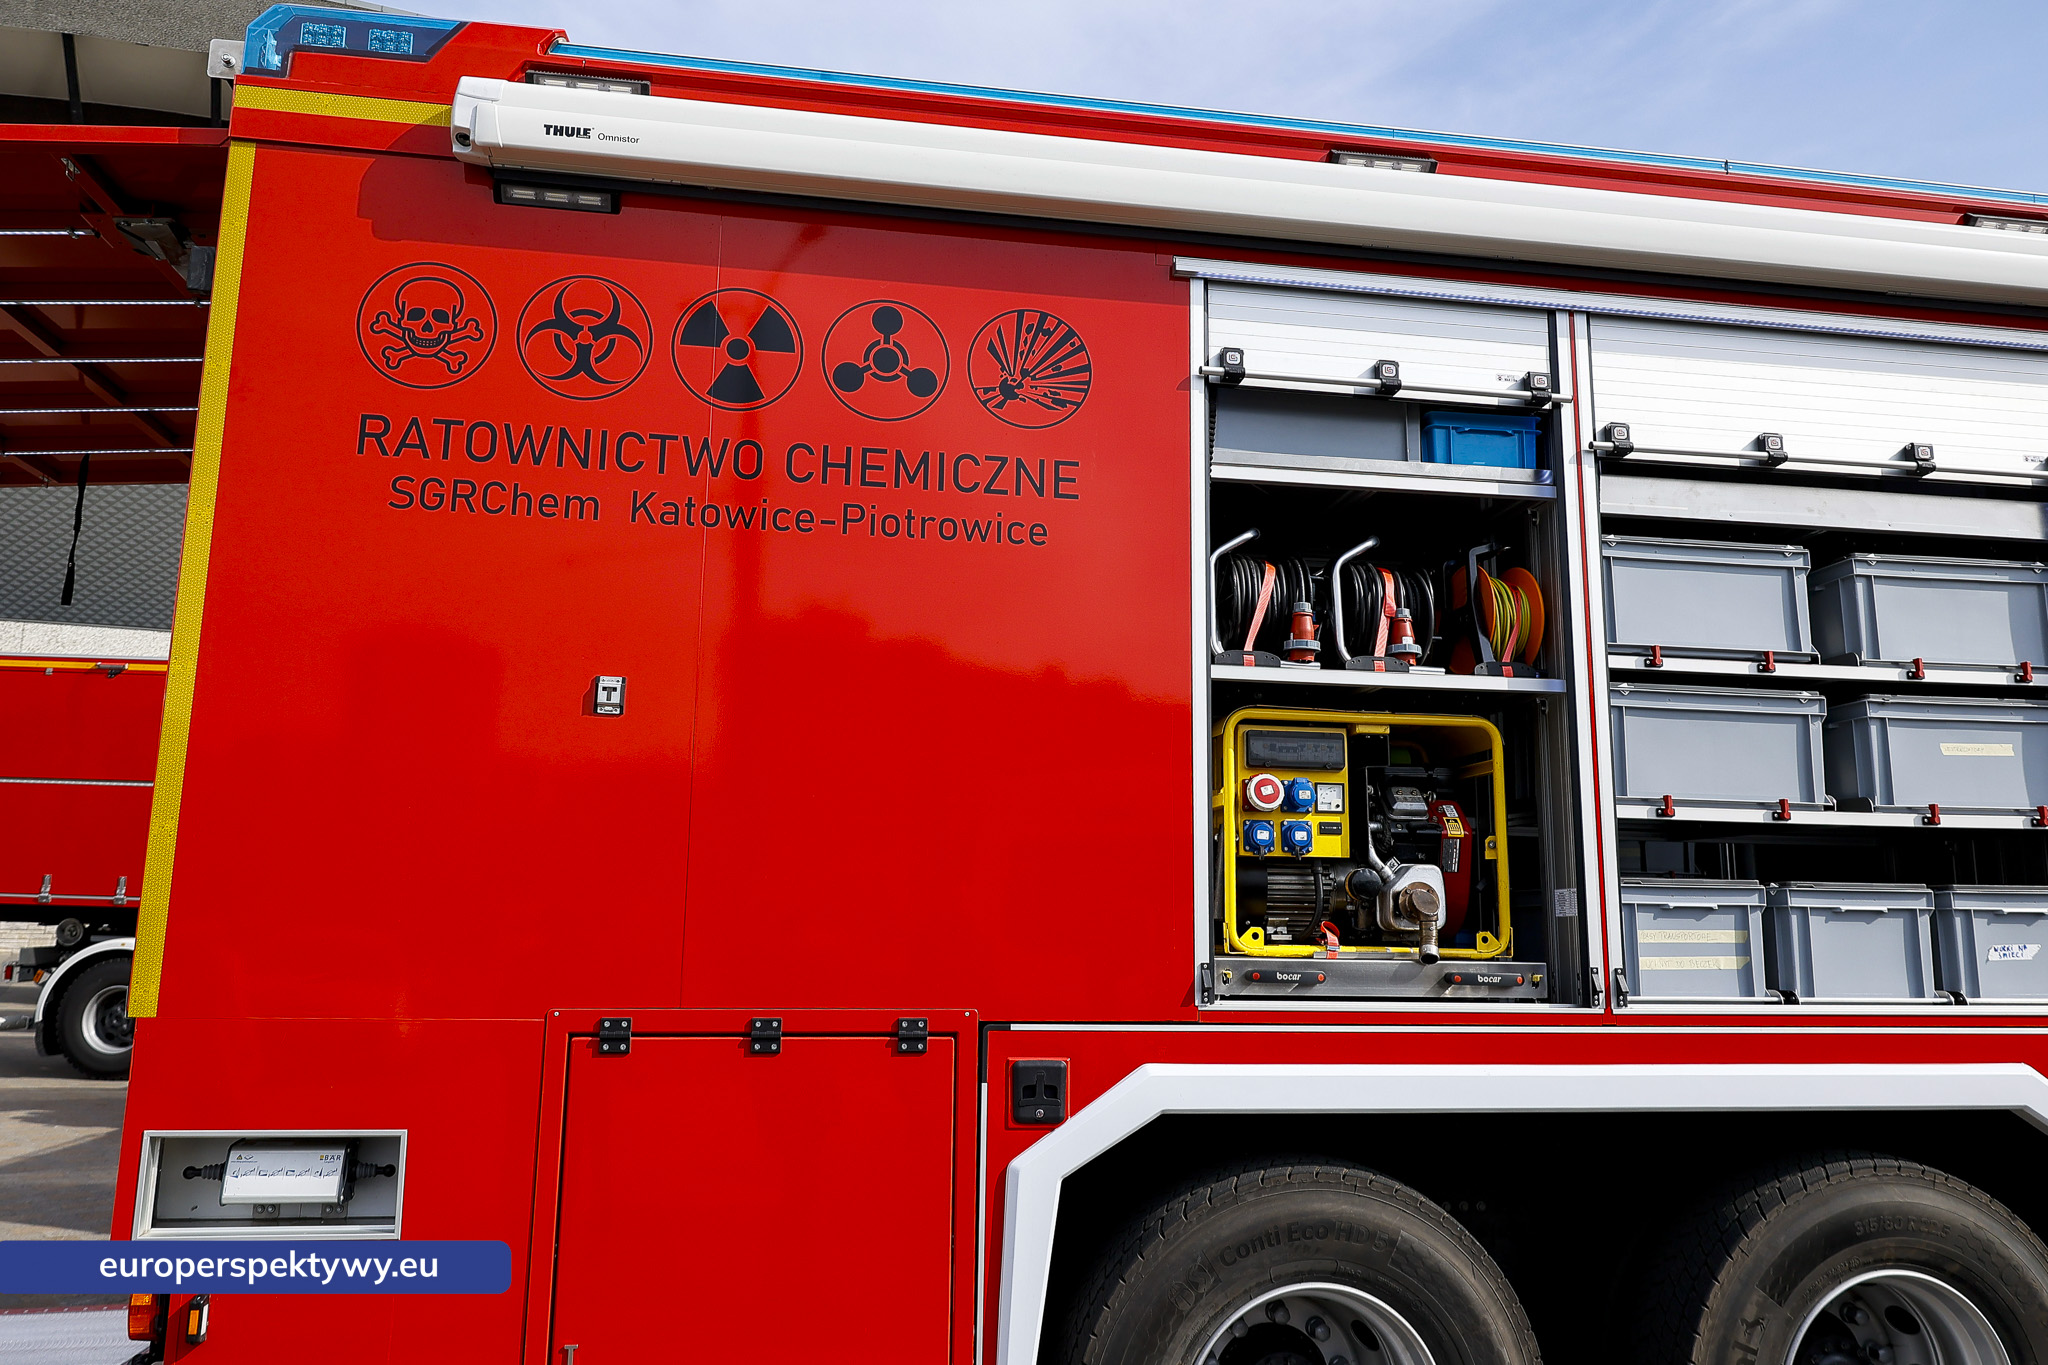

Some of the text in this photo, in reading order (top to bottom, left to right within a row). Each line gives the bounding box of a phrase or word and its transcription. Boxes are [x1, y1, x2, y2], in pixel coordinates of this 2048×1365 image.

[543, 124, 640, 144] THULE Omnistor
[356, 413, 1081, 500] RATOWNICTWO CHEMICZNE
[387, 475, 1049, 546] SGRChem Katowice-Piotrowice
[1276, 971, 1301, 981] bocar
[1477, 974, 1502, 983] bocar
[1219, 1225, 1282, 1267] Conti
[1286, 1221, 1329, 1243] Eco
